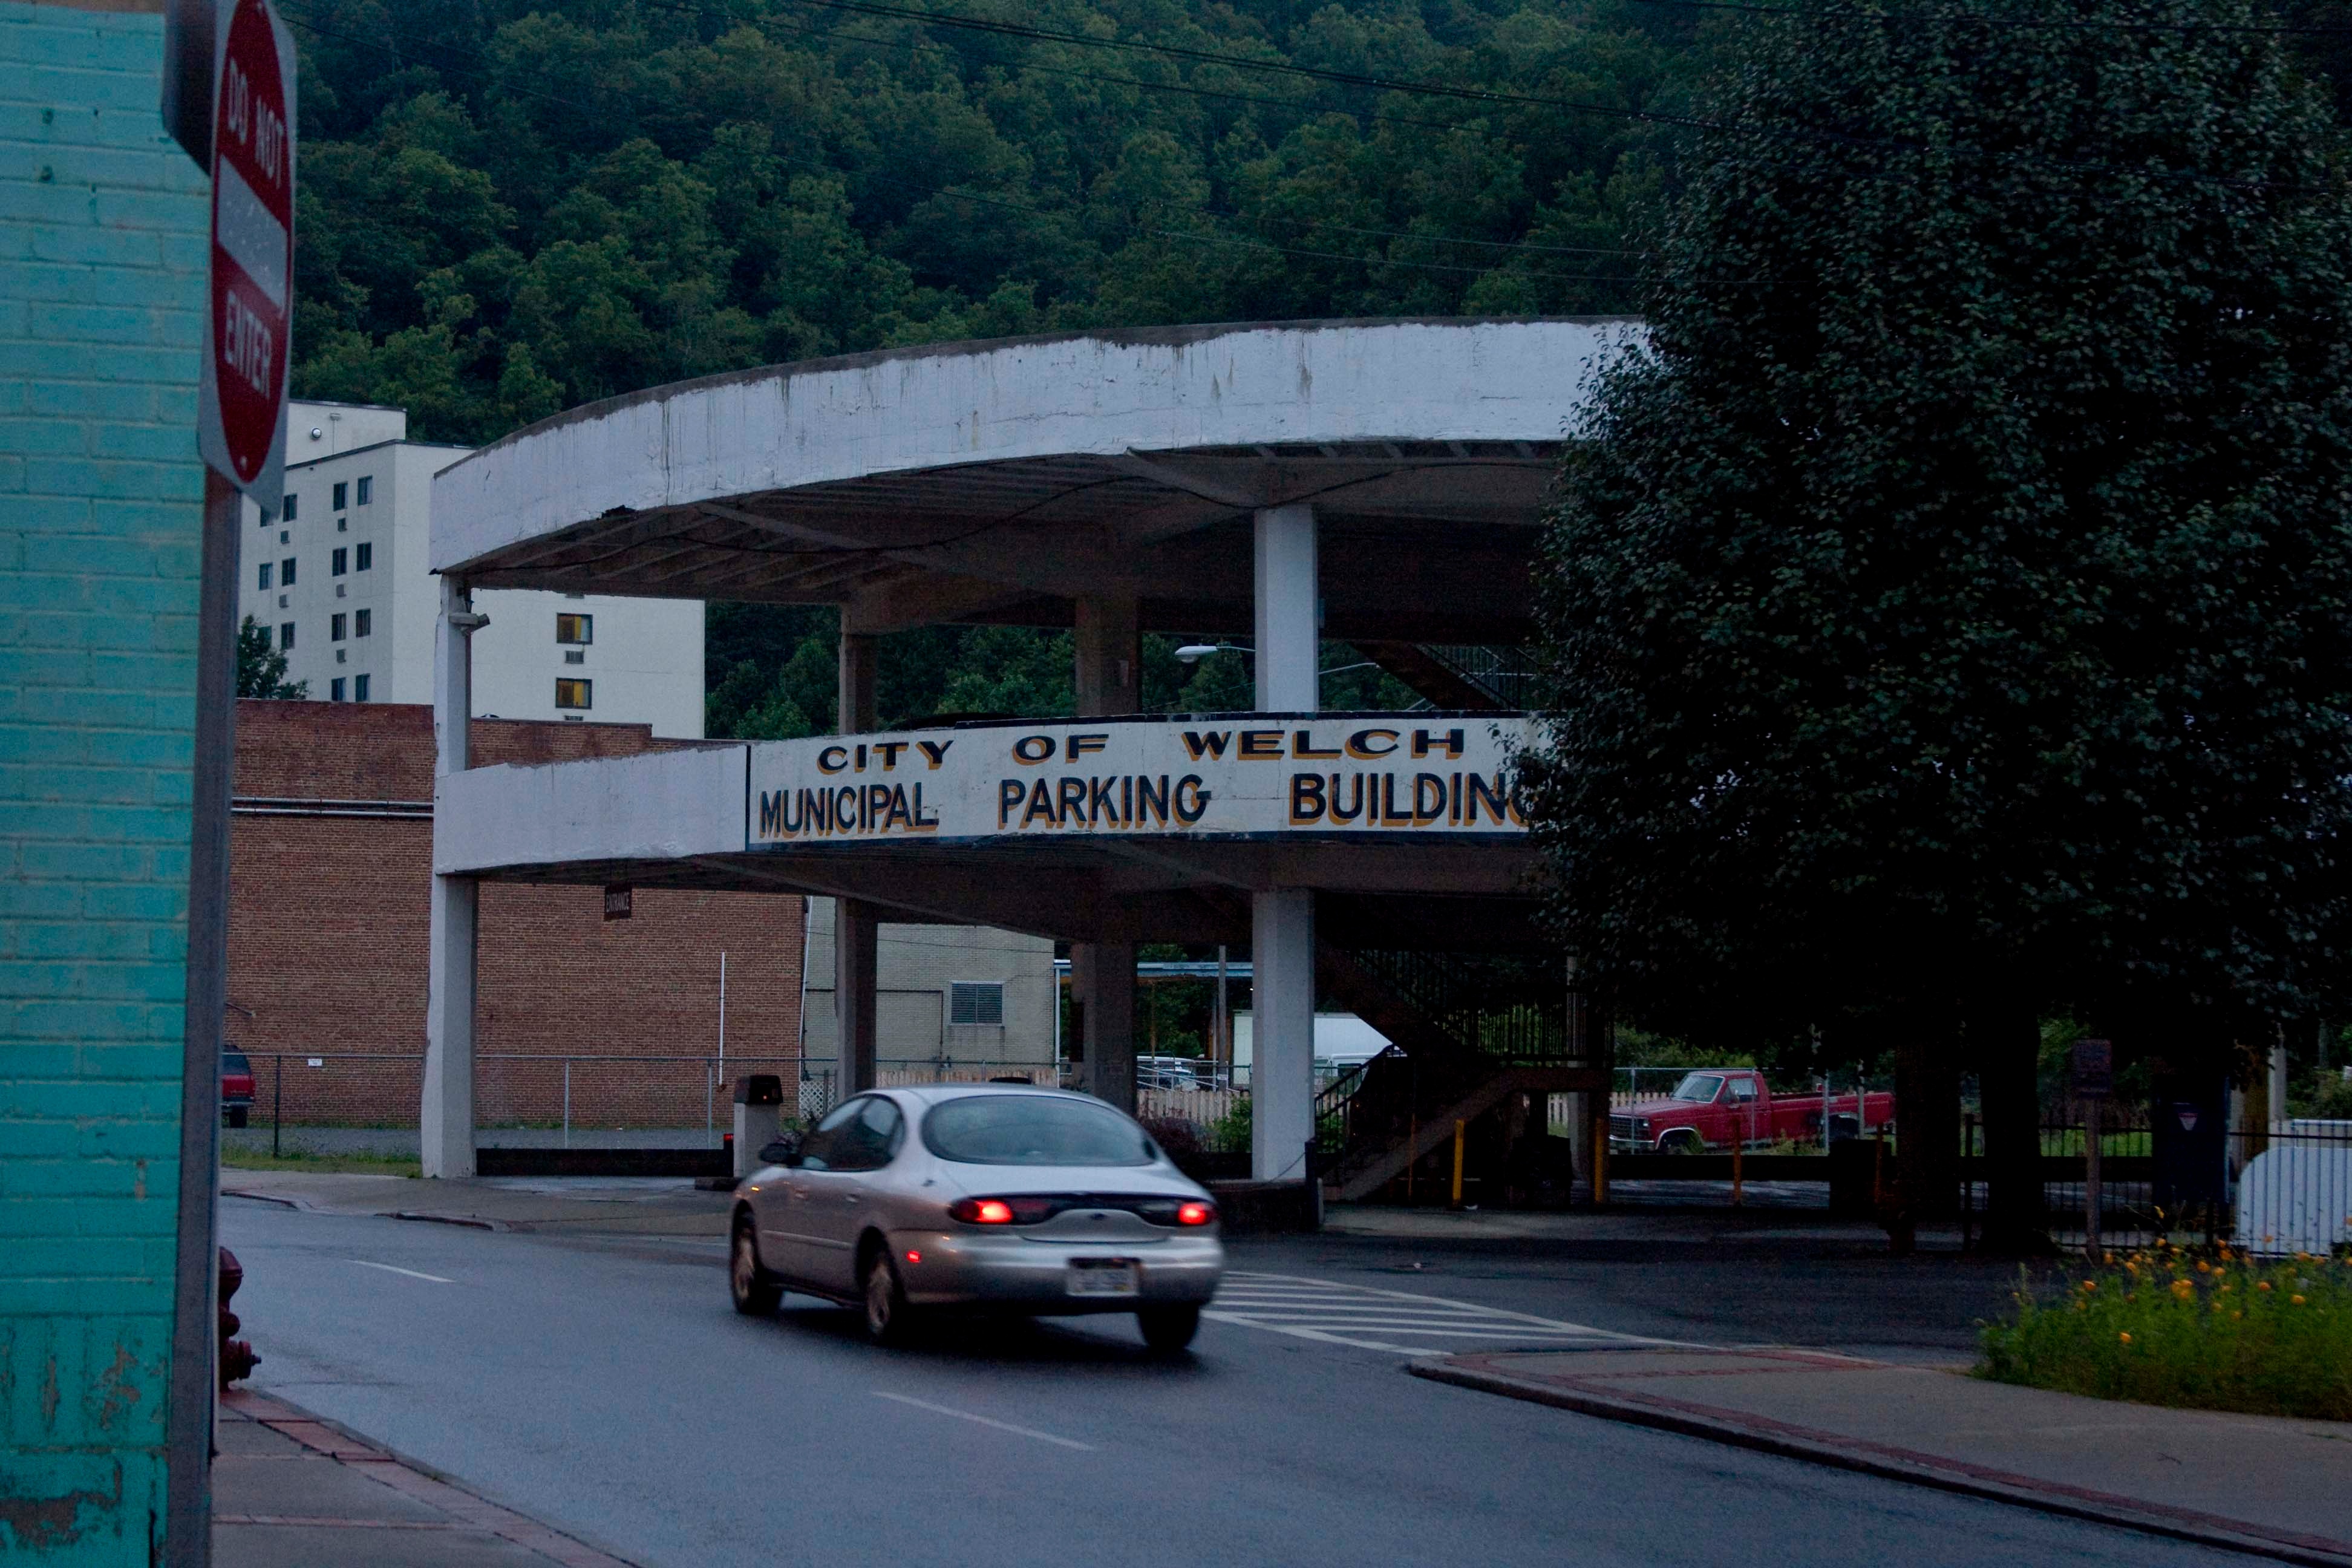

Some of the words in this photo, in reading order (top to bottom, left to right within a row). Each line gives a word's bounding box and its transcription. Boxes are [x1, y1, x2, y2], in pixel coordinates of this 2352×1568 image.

[227, 57, 248, 145] DO
[255, 96, 283, 189] NOT
[225, 290, 272, 400] ENTER
[817, 740, 954, 775] CITY
[1012, 734, 1109, 766] OF
[1181, 728, 1464, 761] WELCH
[759, 782, 939, 838] MUNICIPAL
[997, 774, 1212, 829] PARKING
